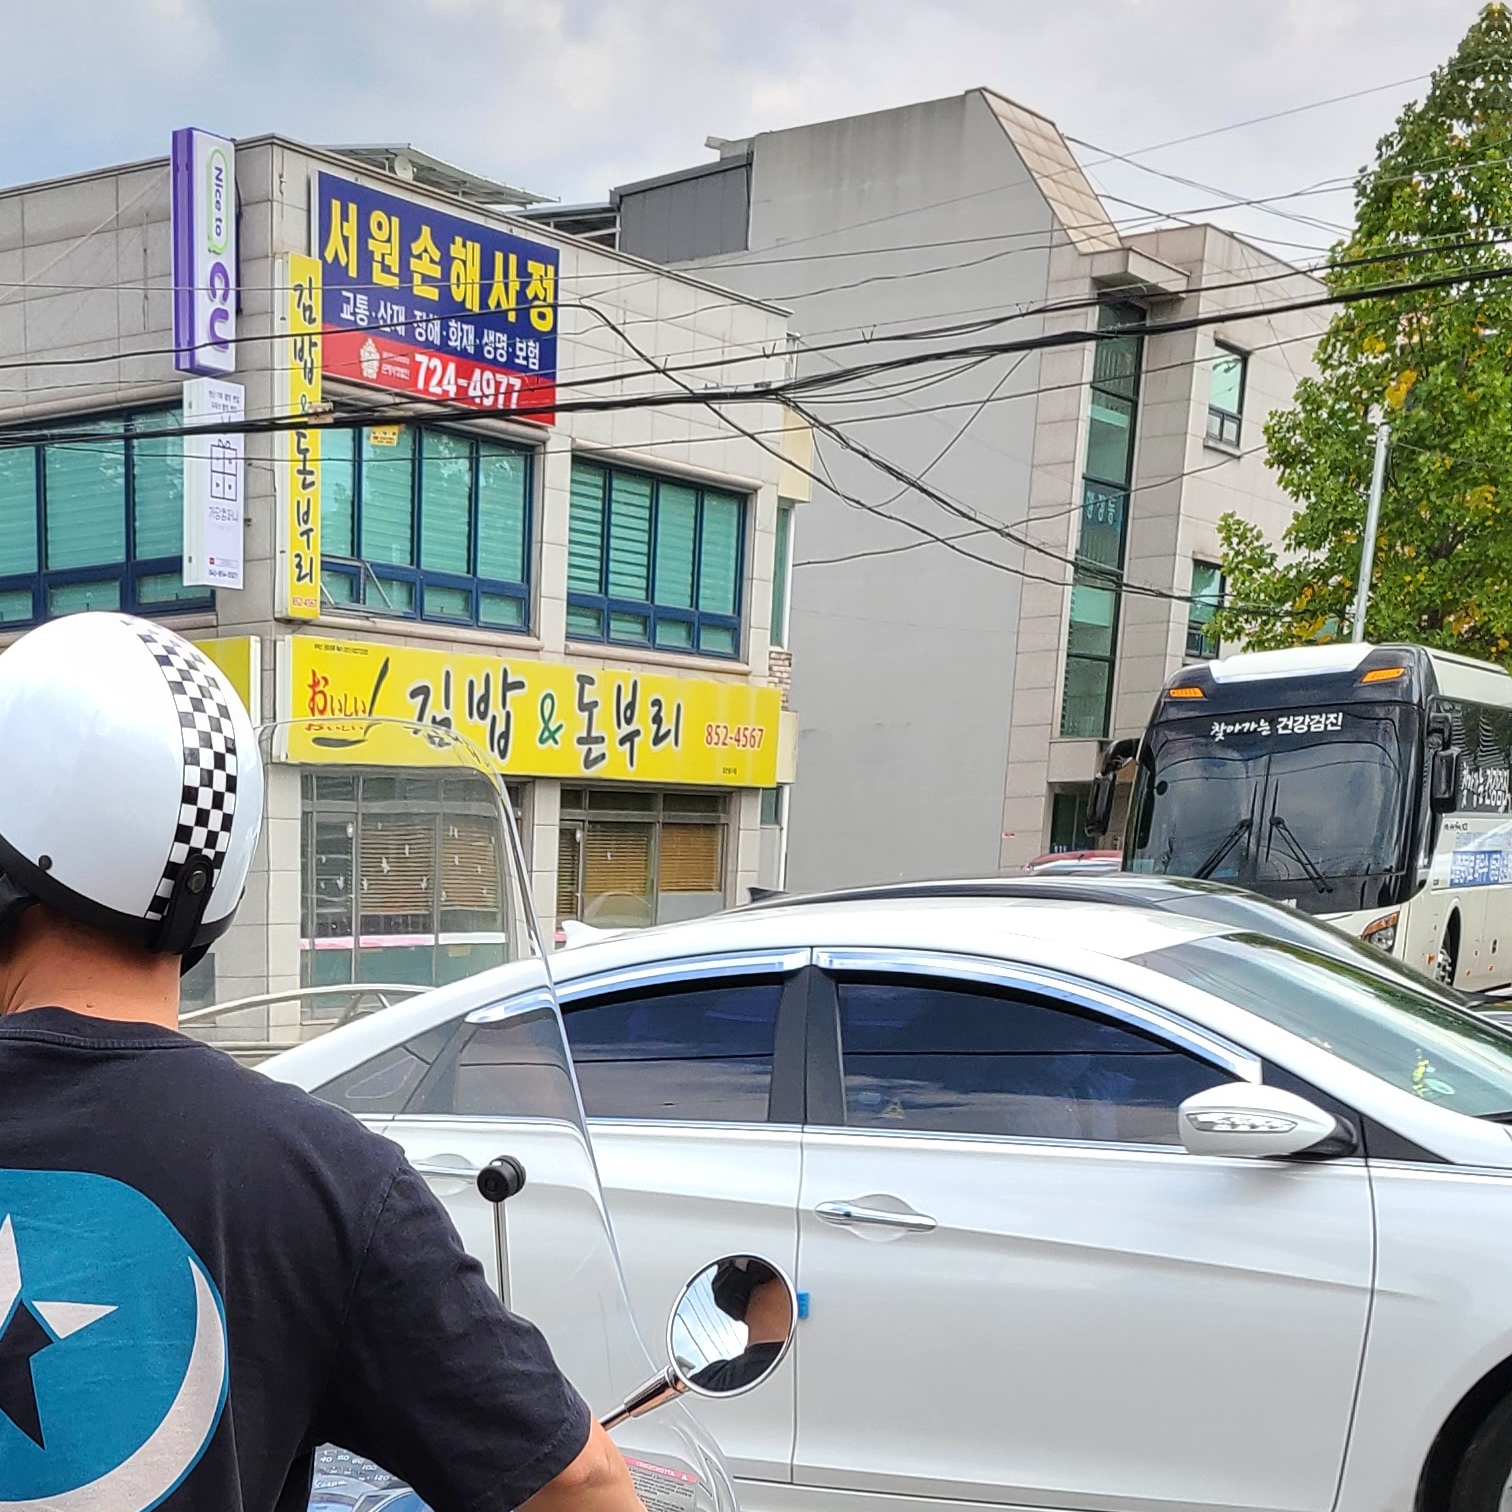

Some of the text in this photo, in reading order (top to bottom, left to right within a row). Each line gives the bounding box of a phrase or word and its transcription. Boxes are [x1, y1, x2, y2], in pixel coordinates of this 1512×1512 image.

[214, 165, 224, 238] Nice to
[324, 199, 556, 333] 서원손해사정
[208, 261, 230, 353] CU
[414, 353, 522, 411] 724-4977
[408, 666, 683, 771] 김밥 & 돈부리
[705, 723, 765, 750] 852-4567
[1209, 712, 1344, 742] 찾아가는 건강검진
